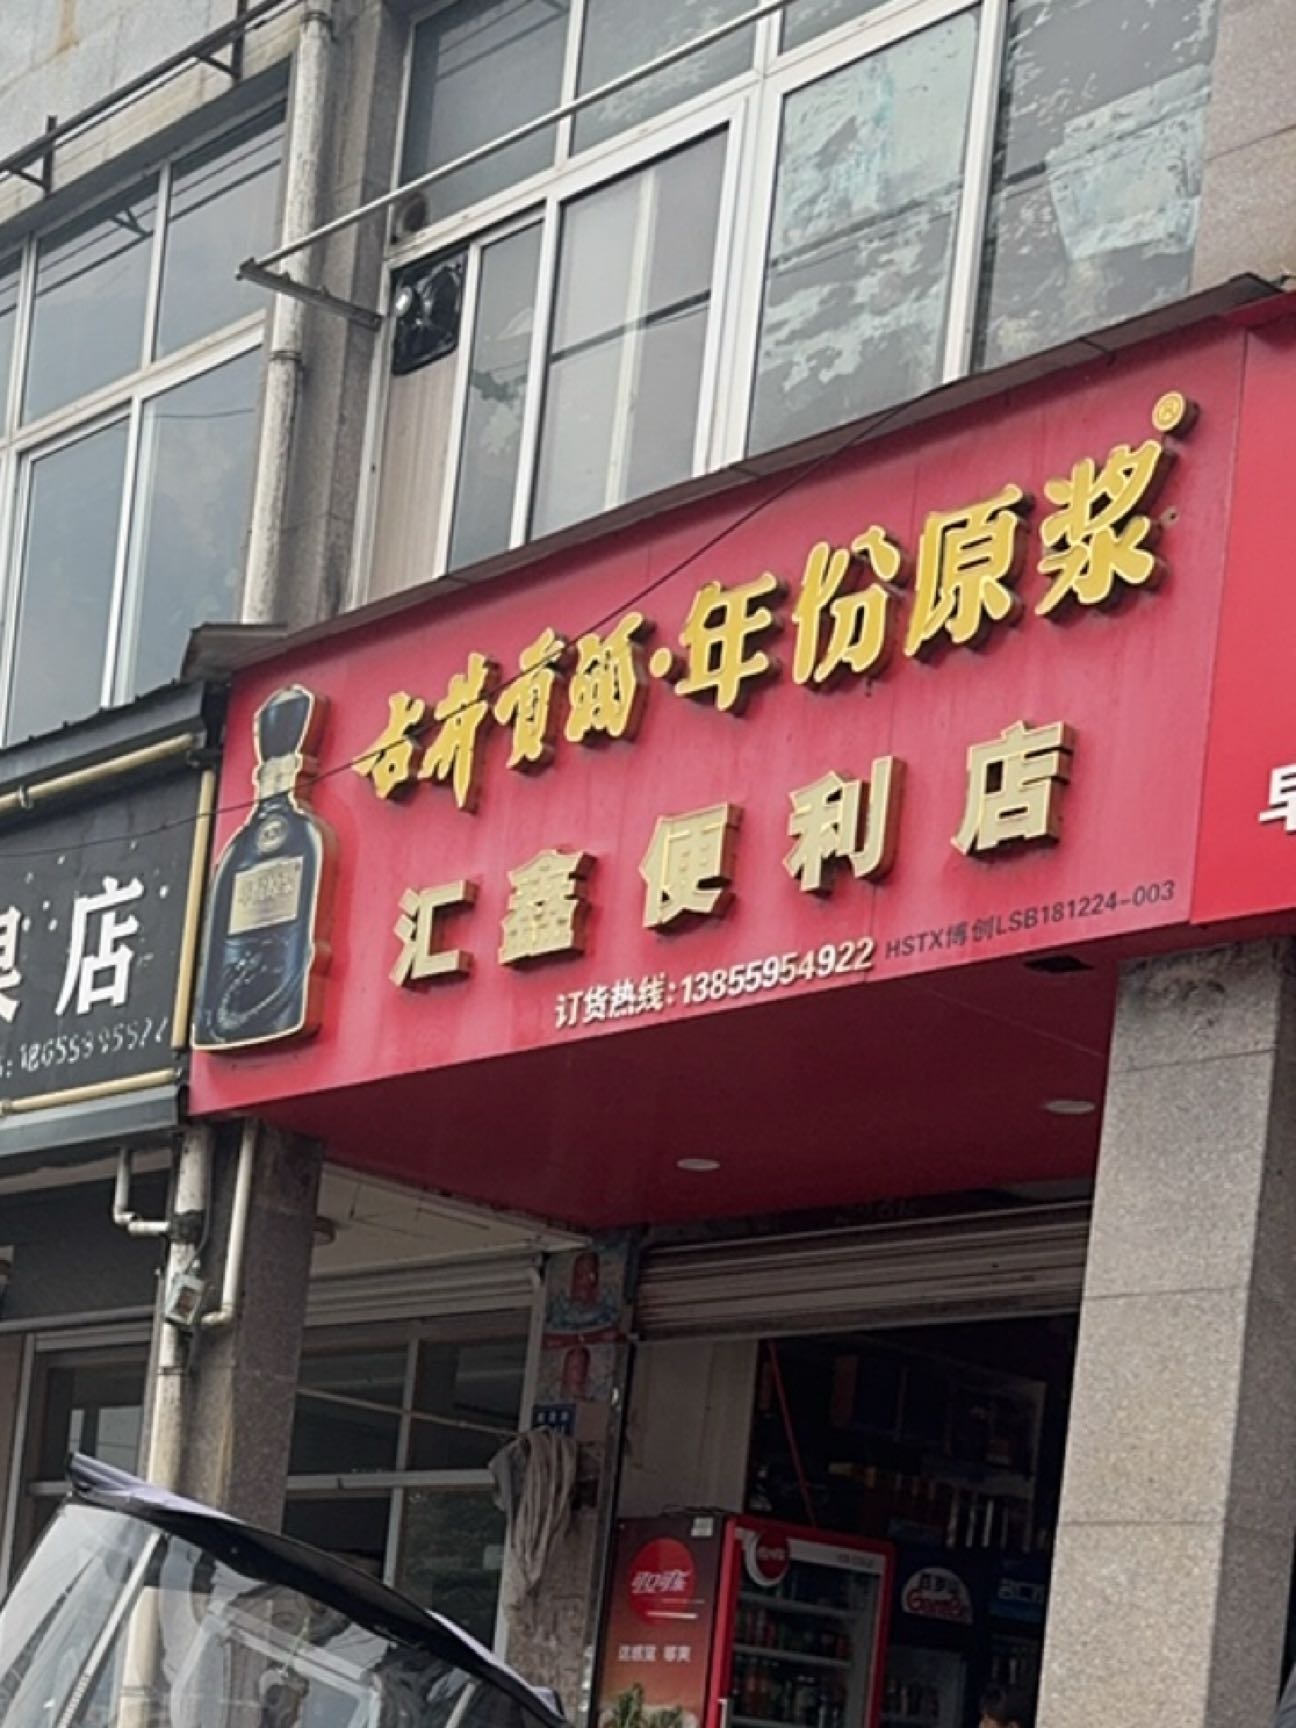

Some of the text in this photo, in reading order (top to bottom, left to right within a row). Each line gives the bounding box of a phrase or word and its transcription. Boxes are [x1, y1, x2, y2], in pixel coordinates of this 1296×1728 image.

[389, 720, 1075, 988] 汇鑫便利店
